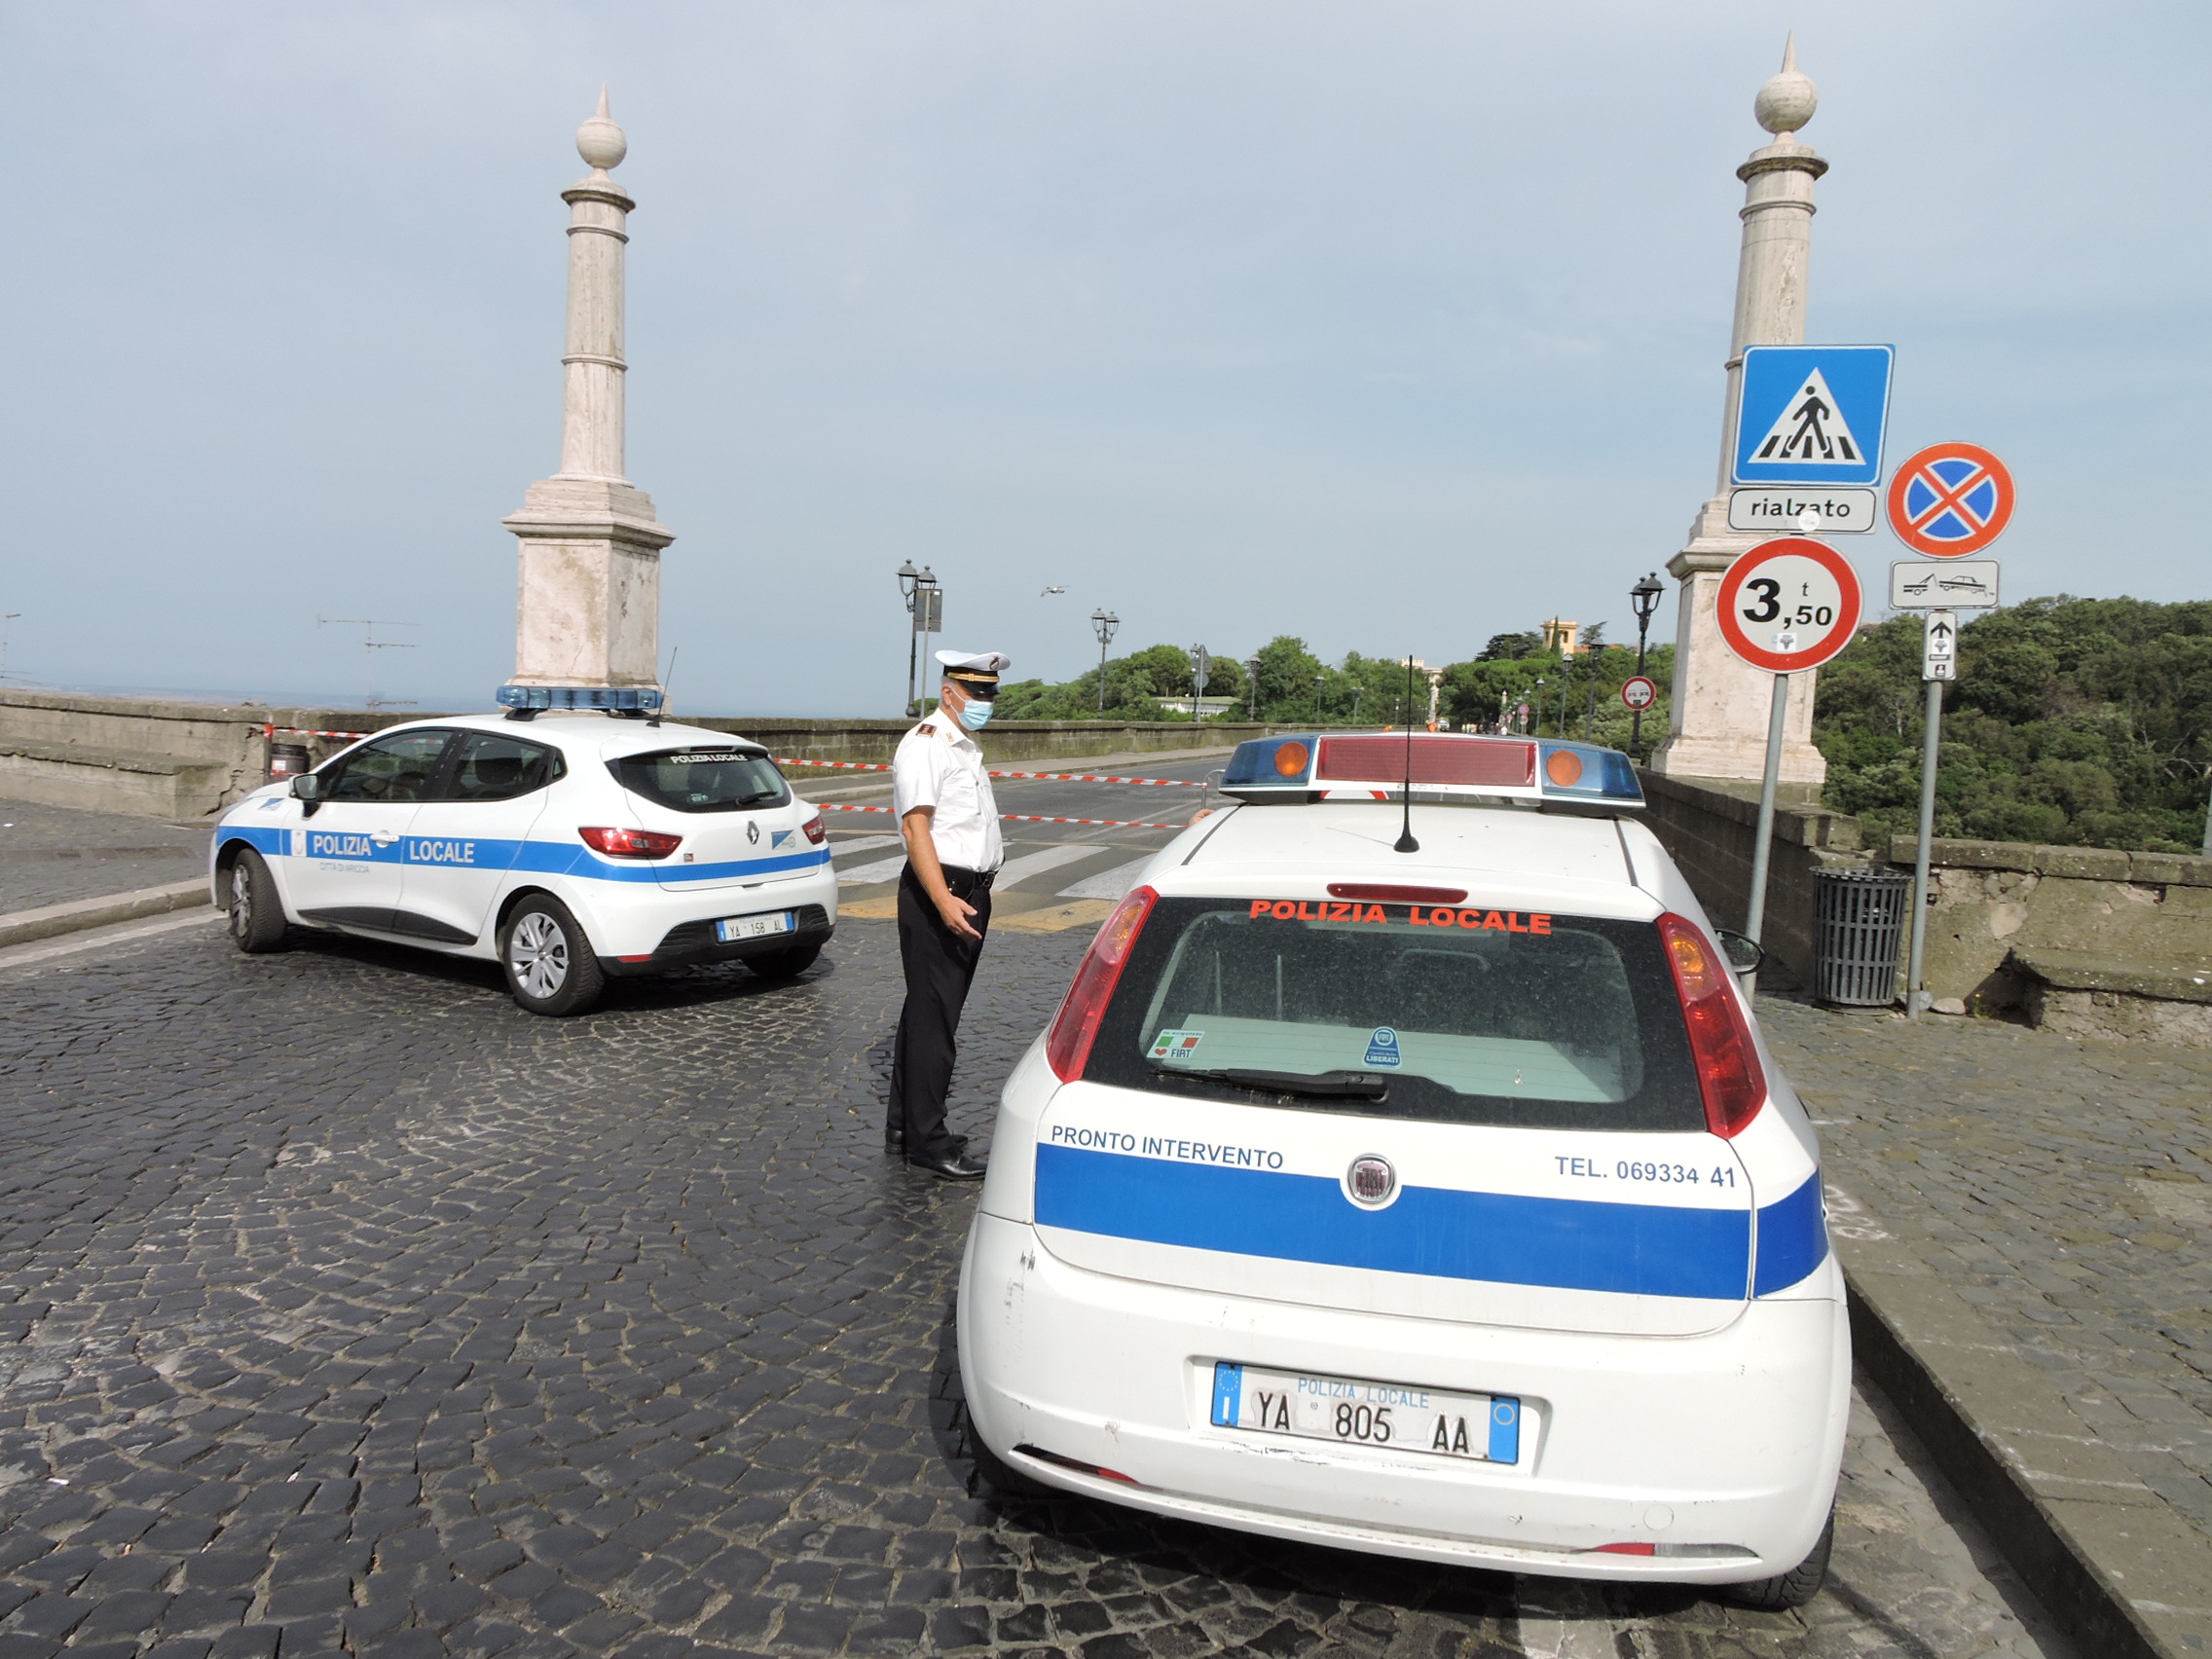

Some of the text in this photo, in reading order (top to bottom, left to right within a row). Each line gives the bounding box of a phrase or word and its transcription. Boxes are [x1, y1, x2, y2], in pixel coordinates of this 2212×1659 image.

[670, 755, 712, 764] POLIZIA
[313, 834, 475, 864] POLIZIA LOCALE
[729, 926, 741, 938] YA
[751, 922, 765, 935] 158
[774, 919, 783, 931] AL
[1249, 900, 1552, 935] POLIZIA LOCALE
[1170, 1049, 1192, 1058] FIAT
[1366, 1054, 1399, 1063] LIBERATI
[1051, 1124, 1283, 1169] PRONTO INTERVENTO
[1555, 1156, 1735, 1188] TEL. 069334 41
[1298, 1378, 1429, 1409] POLIZIA LOCALE
[1258, 1391, 1469, 1454] YA 805 AA
